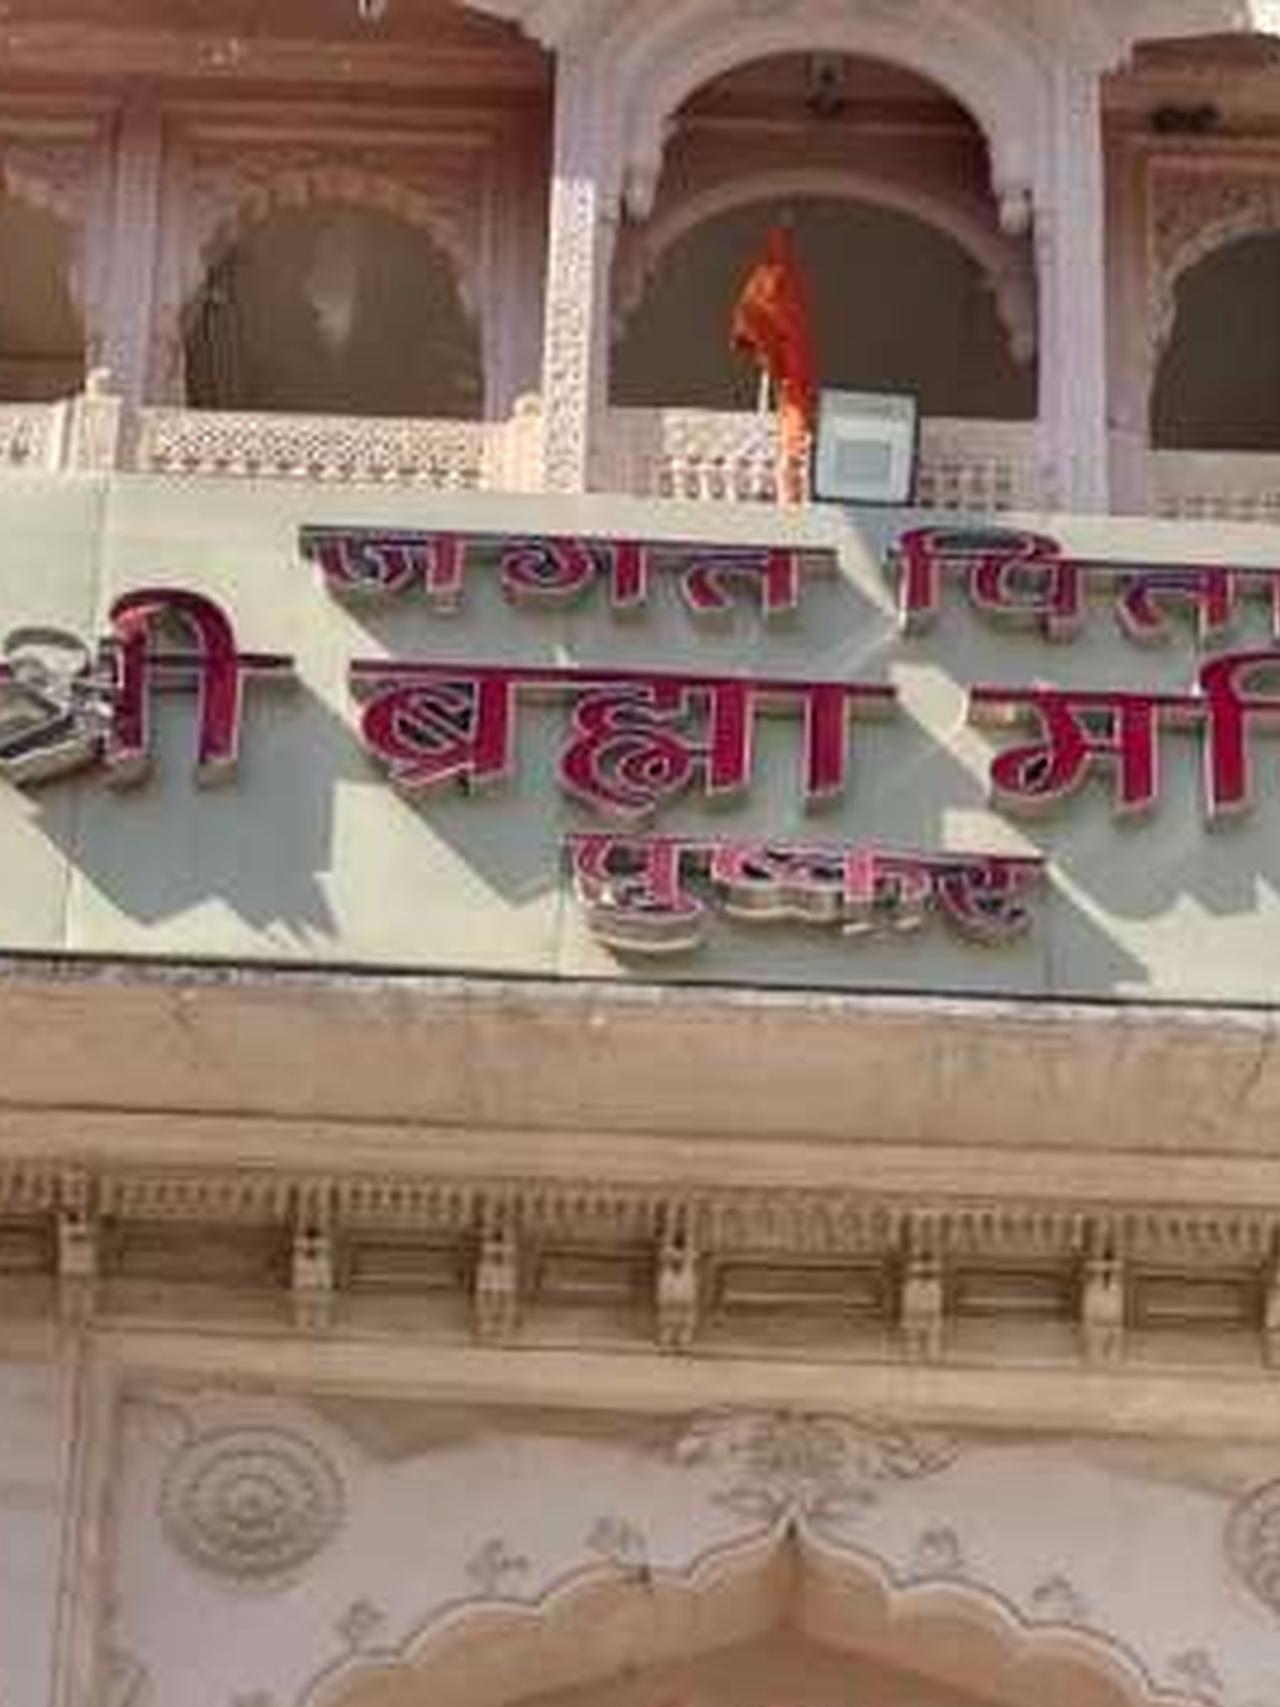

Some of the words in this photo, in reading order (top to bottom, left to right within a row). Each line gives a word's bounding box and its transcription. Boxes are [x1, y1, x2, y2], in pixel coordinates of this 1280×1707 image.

[298, 526, 839, 612] जगत
[348, 658, 897, 820] ब्रह्मा
[564, 832, 1046, 950] पुष्कर
